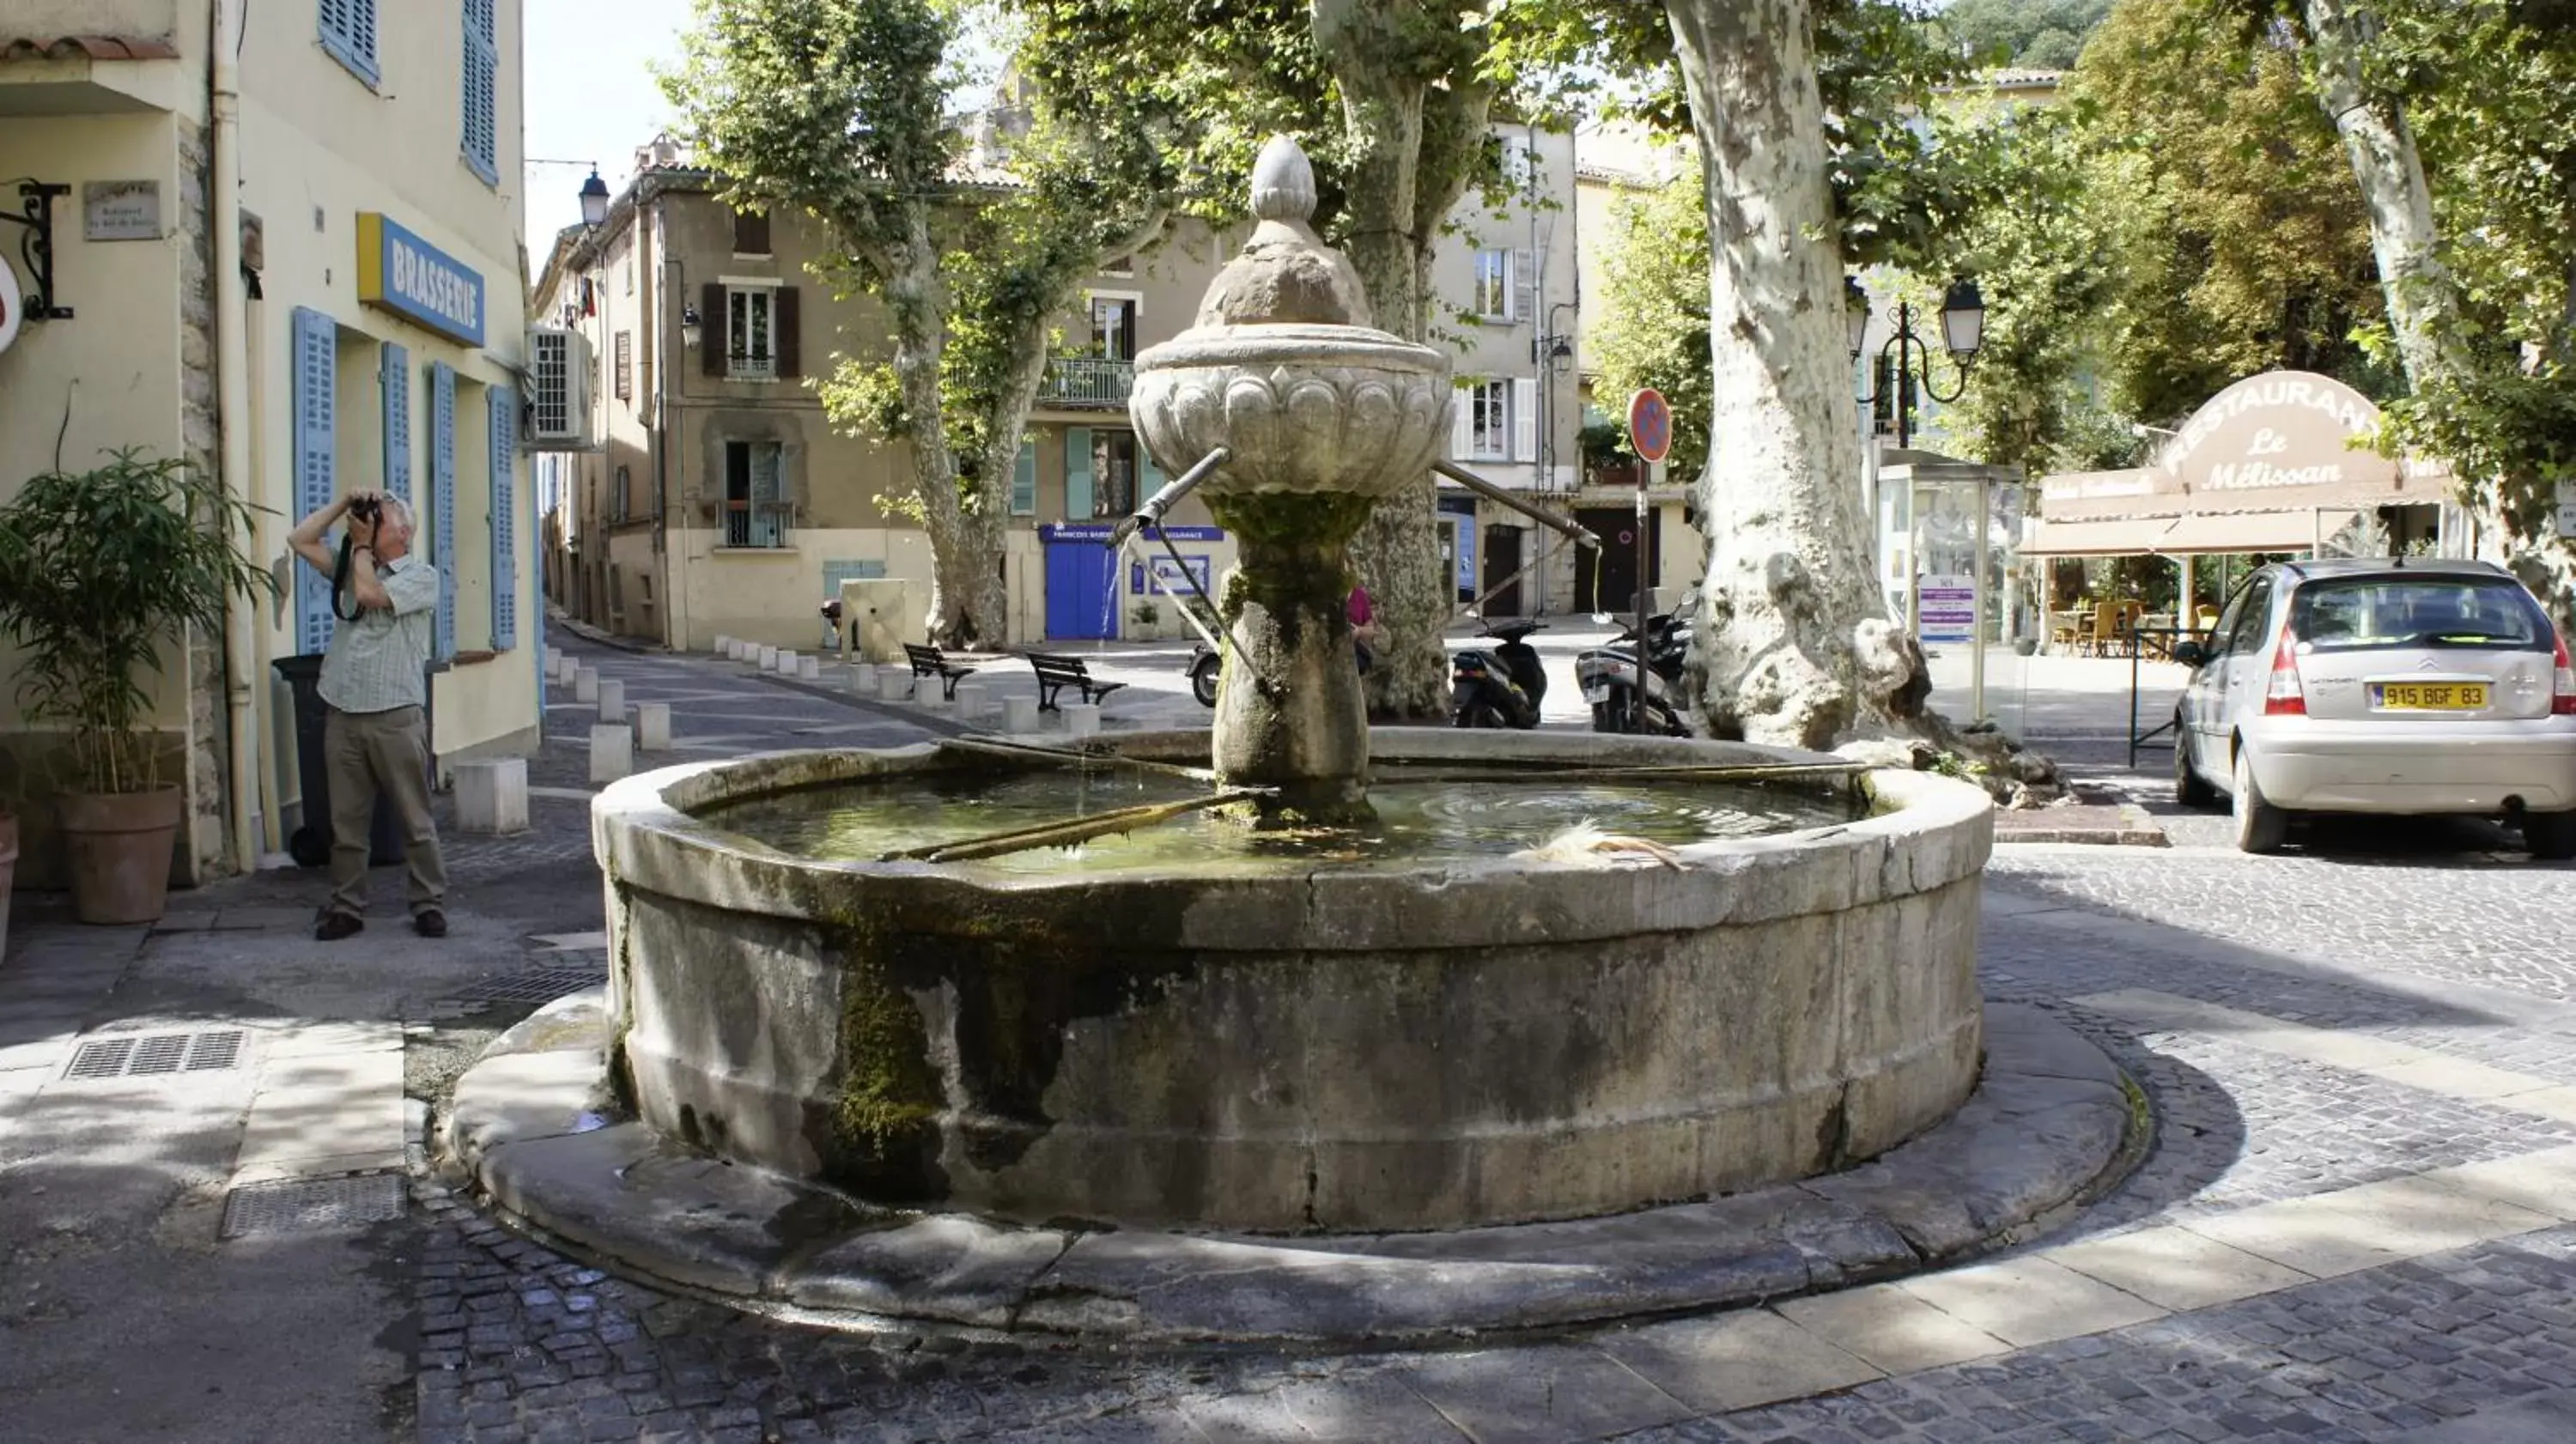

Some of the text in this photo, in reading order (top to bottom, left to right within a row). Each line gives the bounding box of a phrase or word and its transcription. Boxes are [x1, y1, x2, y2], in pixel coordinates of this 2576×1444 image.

[392, 237, 477, 330] BRASSERIE
[2245, 427, 2288, 457] Le
[2201, 460, 2343, 490] Mélissan
[2387, 688, 2482, 705] 915 BGF 83
